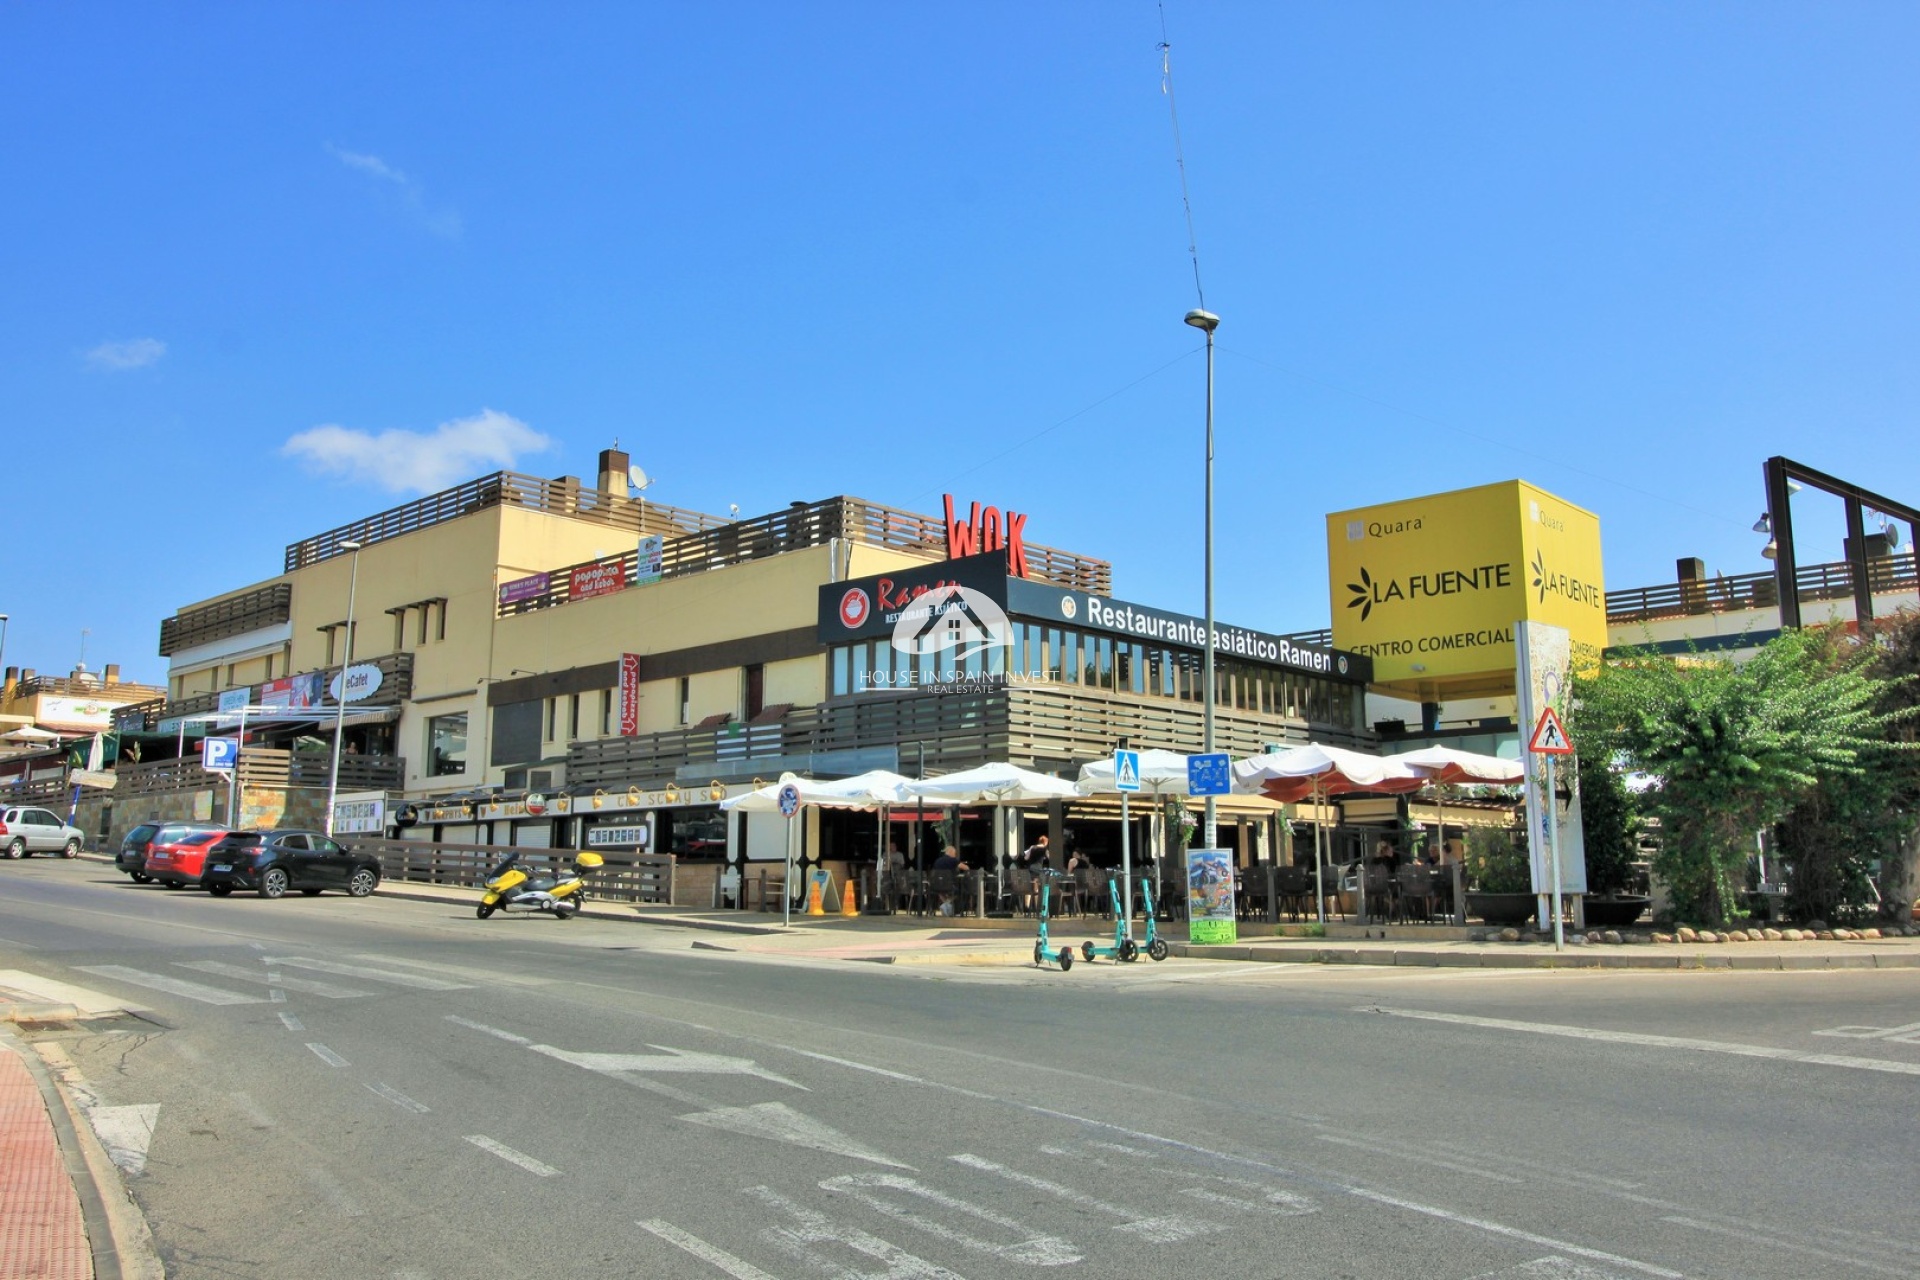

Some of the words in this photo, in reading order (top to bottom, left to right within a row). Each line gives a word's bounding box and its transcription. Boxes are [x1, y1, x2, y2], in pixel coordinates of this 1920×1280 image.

[943, 494, 1028, 578] WOK
[1369, 518, 1422, 537] Quara
[1540, 510, 1563, 532] Quara
[876, 578, 964, 611] Ramen
[1373, 579, 1404, 603] LA
[1410, 563, 1511, 598] FUENTE
[1543, 568, 1559, 594] LA
[1560, 574, 1599, 608] FUENTE
[885, 605, 934, 624] RESTAURANTE
[1088, 597, 1206, 646] Restaurante
[1212, 628, 1277, 660] asiático
[1279, 639, 1331, 672] Ramen
[1418, 627, 1515, 652] COMERCIAL
[207, 740, 228, 767] P
